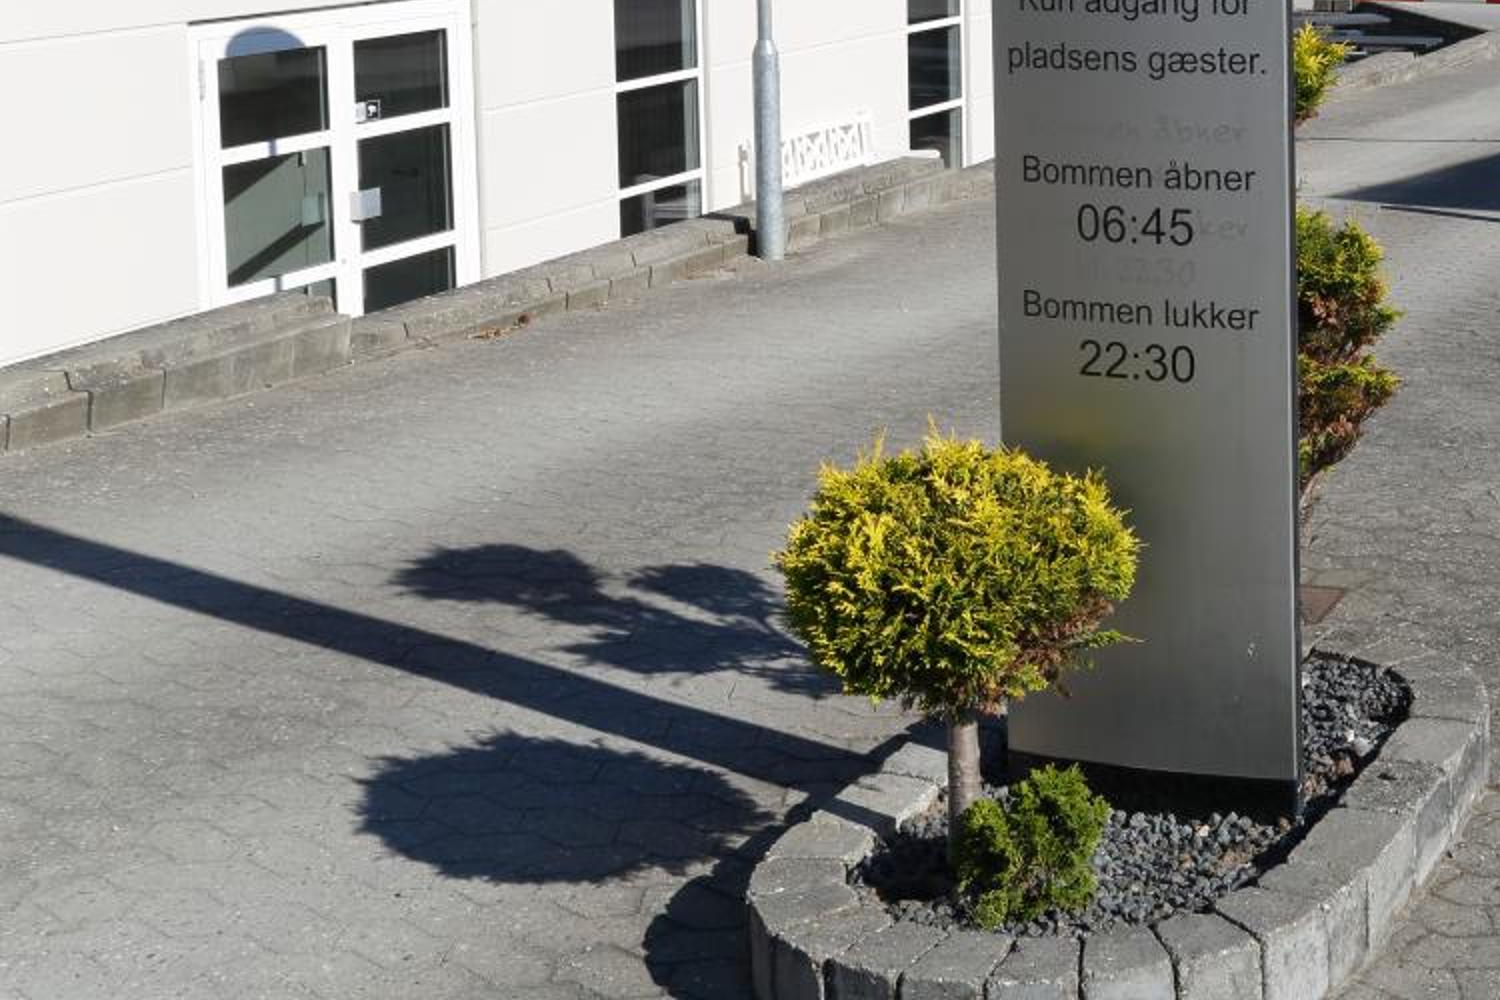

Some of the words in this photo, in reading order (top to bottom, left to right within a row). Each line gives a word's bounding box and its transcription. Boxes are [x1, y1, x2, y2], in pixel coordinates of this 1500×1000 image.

[1008, 41, 1137, 74] pladsens
[1148, 48, 1266, 80] gæster.
[1023, 155, 1153, 188] Bommen
[1164, 161, 1256, 191] åbner
[1078, 204, 1194, 246] 06:45
[1024, 290, 1152, 325] Bommen
[1165, 299, 1260, 330] lukker
[1080, 340, 1195, 383] 22:30
